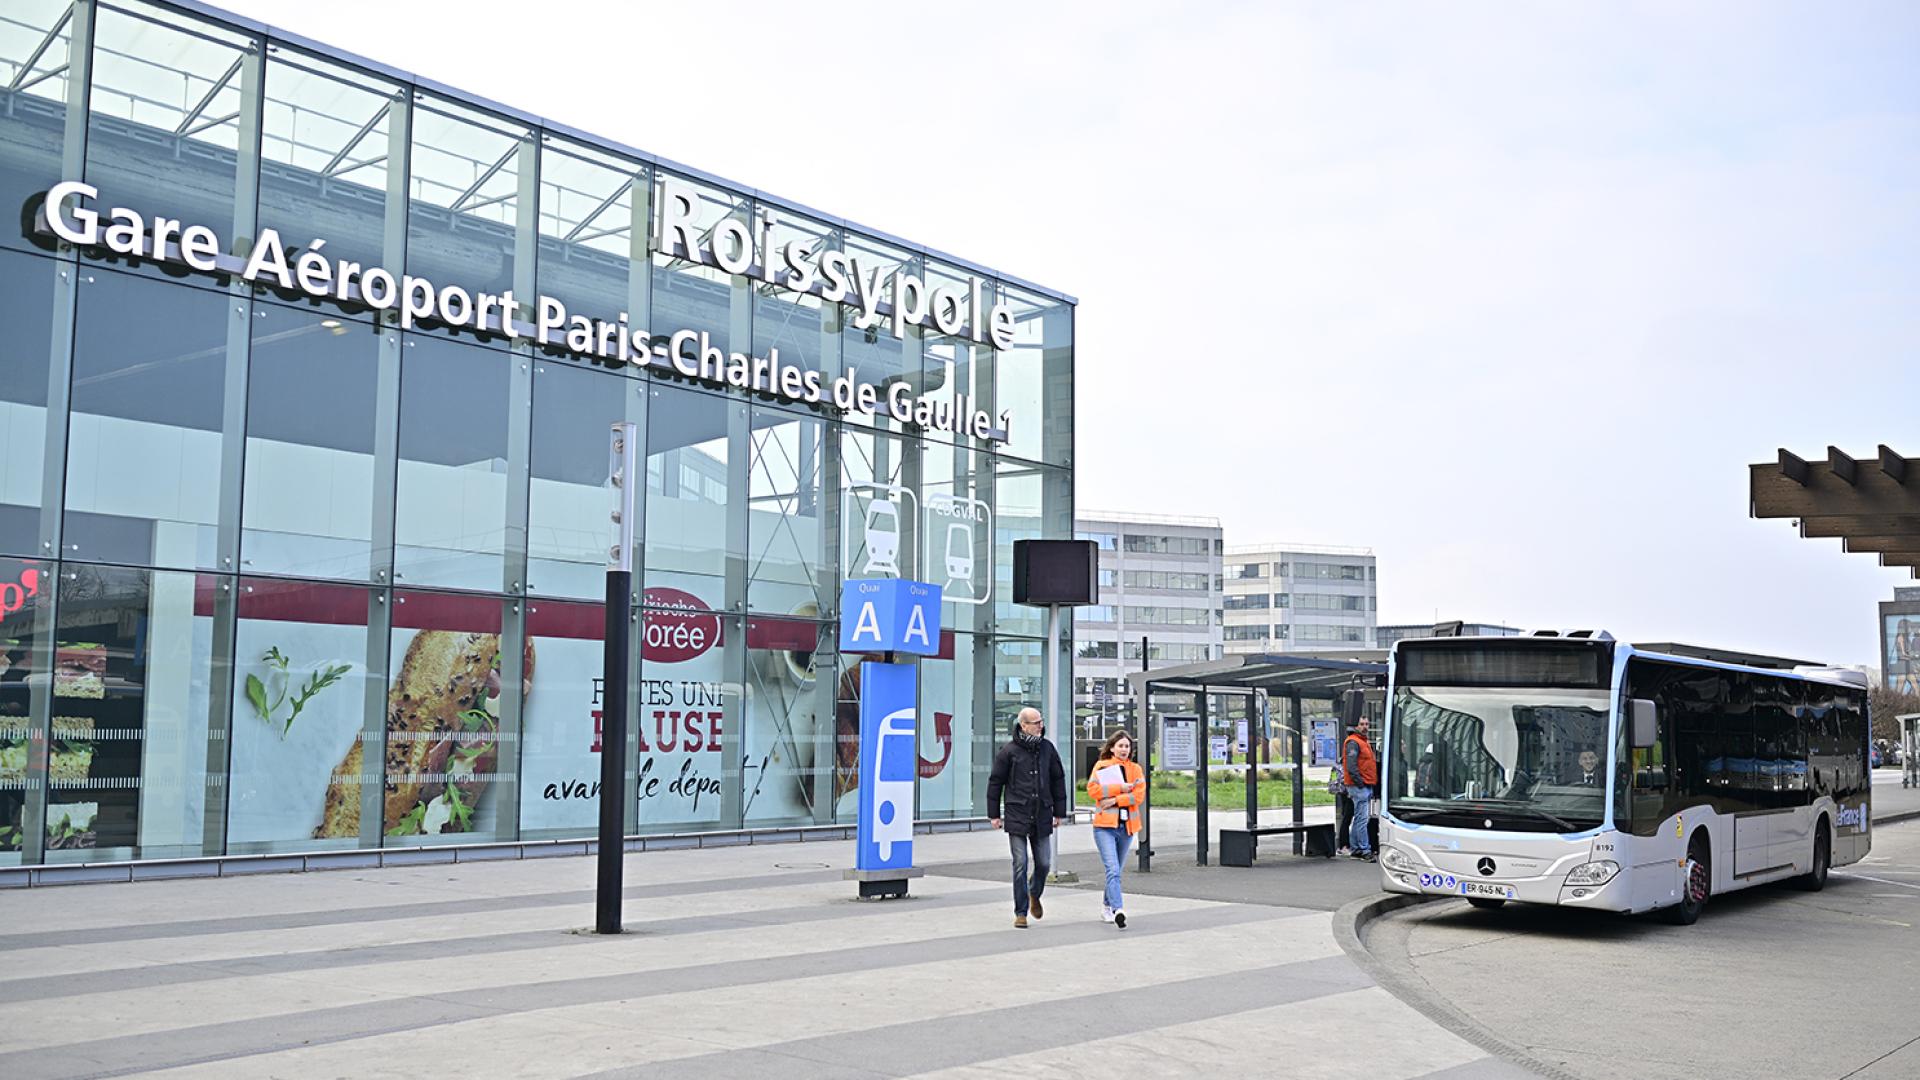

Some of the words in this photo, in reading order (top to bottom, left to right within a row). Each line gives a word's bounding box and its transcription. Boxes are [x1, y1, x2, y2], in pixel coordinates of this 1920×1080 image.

[658, 178, 1016, 350] Roissypole
[45, 181, 219, 271] Gare
[243, 228, 520, 338] Aéroport
[537, 295, 821, 403] Paris-Charles
[834, 367, 877, 415] de
[889, 381, 992, 440] Gaulle
[1000, 408, 1014, 446] 1
[858, 583, 881, 594] Quai
[910, 585, 929, 596] Quai
[642, 622, 705, 650] orée
[851, 601, 882, 642] A
[903, 604, 930, 647] A
[1596, 844, 1615, 852] 8192
